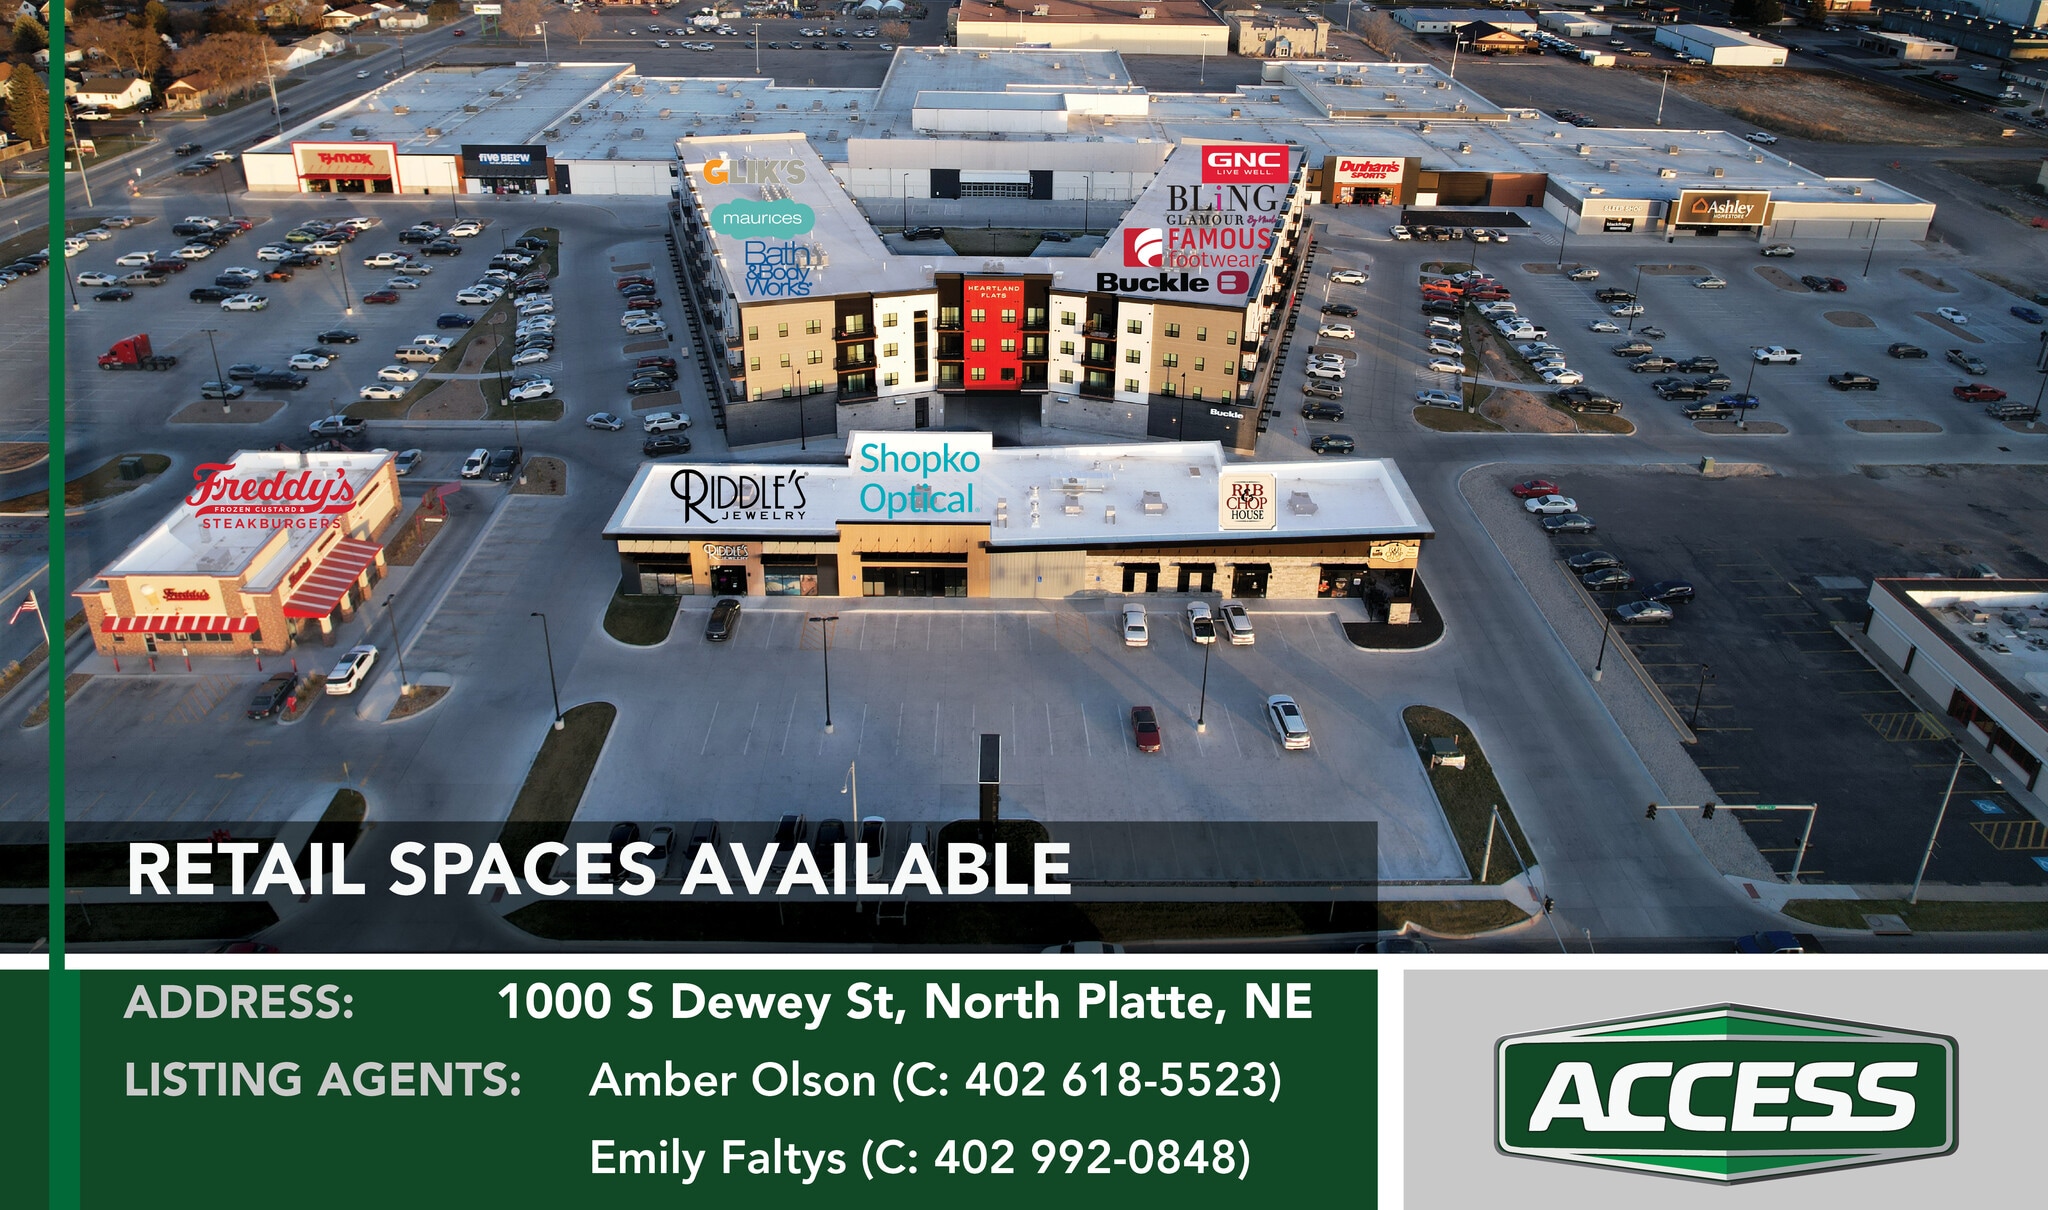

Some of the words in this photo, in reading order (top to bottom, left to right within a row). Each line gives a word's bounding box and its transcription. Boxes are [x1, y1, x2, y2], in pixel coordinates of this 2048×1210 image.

[1339, 161, 1400, 172] Dunham's
[1707, 199, 1755, 218] Ashley
[1209, 408, 1244, 419] Buckle
[703, 544, 749, 560] RIDDLE'S
[163, 588, 210, 601] Freddy's
